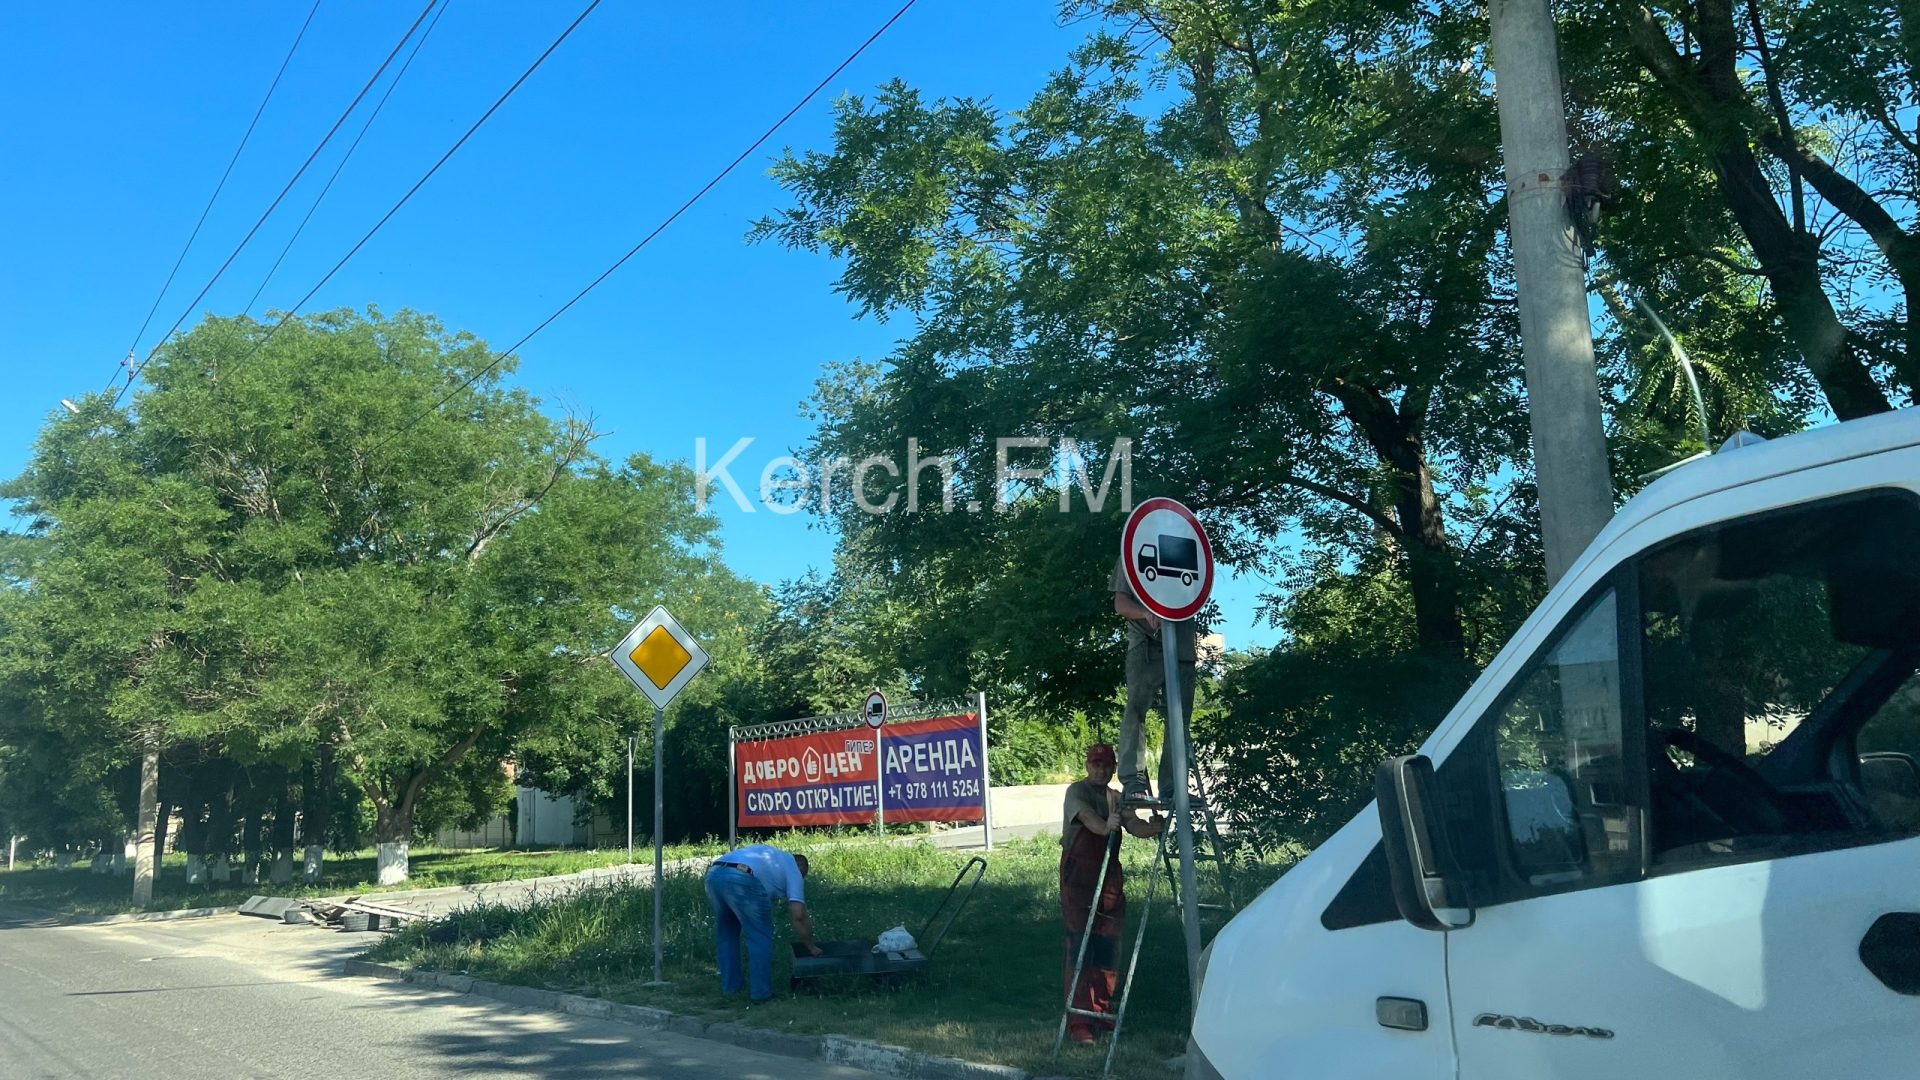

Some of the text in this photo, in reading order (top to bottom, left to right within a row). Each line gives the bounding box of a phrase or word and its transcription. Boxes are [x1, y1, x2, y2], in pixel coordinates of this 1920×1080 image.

[845, 740, 874, 754] ГИПЕР
[886, 738, 977, 776] АРЕНДА
[744, 752, 862, 784] ДОБРО ЦЕН
[747, 785, 878, 812] СКОРО ОТКРЫТИЕ!
[888, 779, 979, 799] +7 978 111 5254
